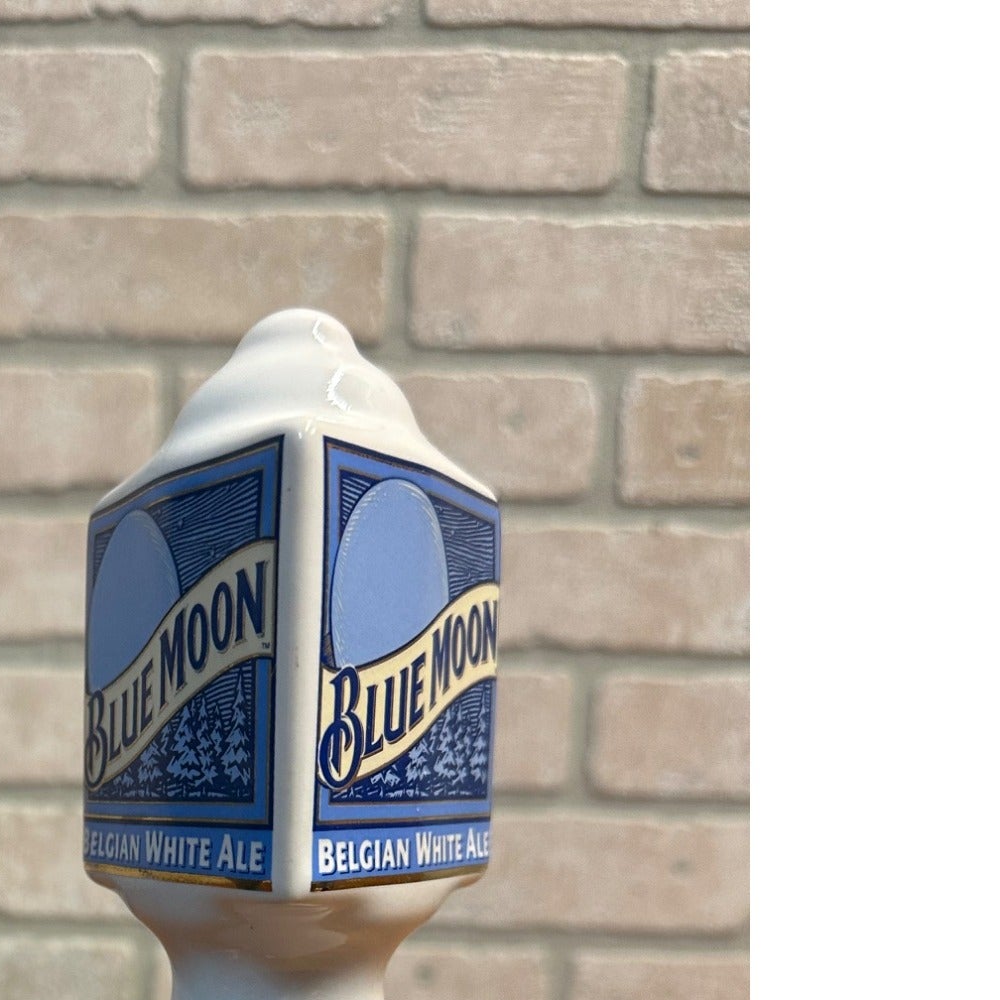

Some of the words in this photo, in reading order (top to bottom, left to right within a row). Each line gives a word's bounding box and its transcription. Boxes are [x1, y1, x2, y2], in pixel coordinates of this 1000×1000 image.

[85, 658, 154, 789] BLUE
[160, 560, 268, 709] MOON
[319, 652, 426, 791] BLUE
[430, 600, 498, 706] MOON
[84, 827, 141, 862] BELGIAN
[145, 830, 212, 869] WHITE
[216, 833, 265, 874] ALE
[317, 837, 411, 876] BELGIAN
[415, 831, 463, 867] WHITE
[466, 827, 489, 860] ALE
